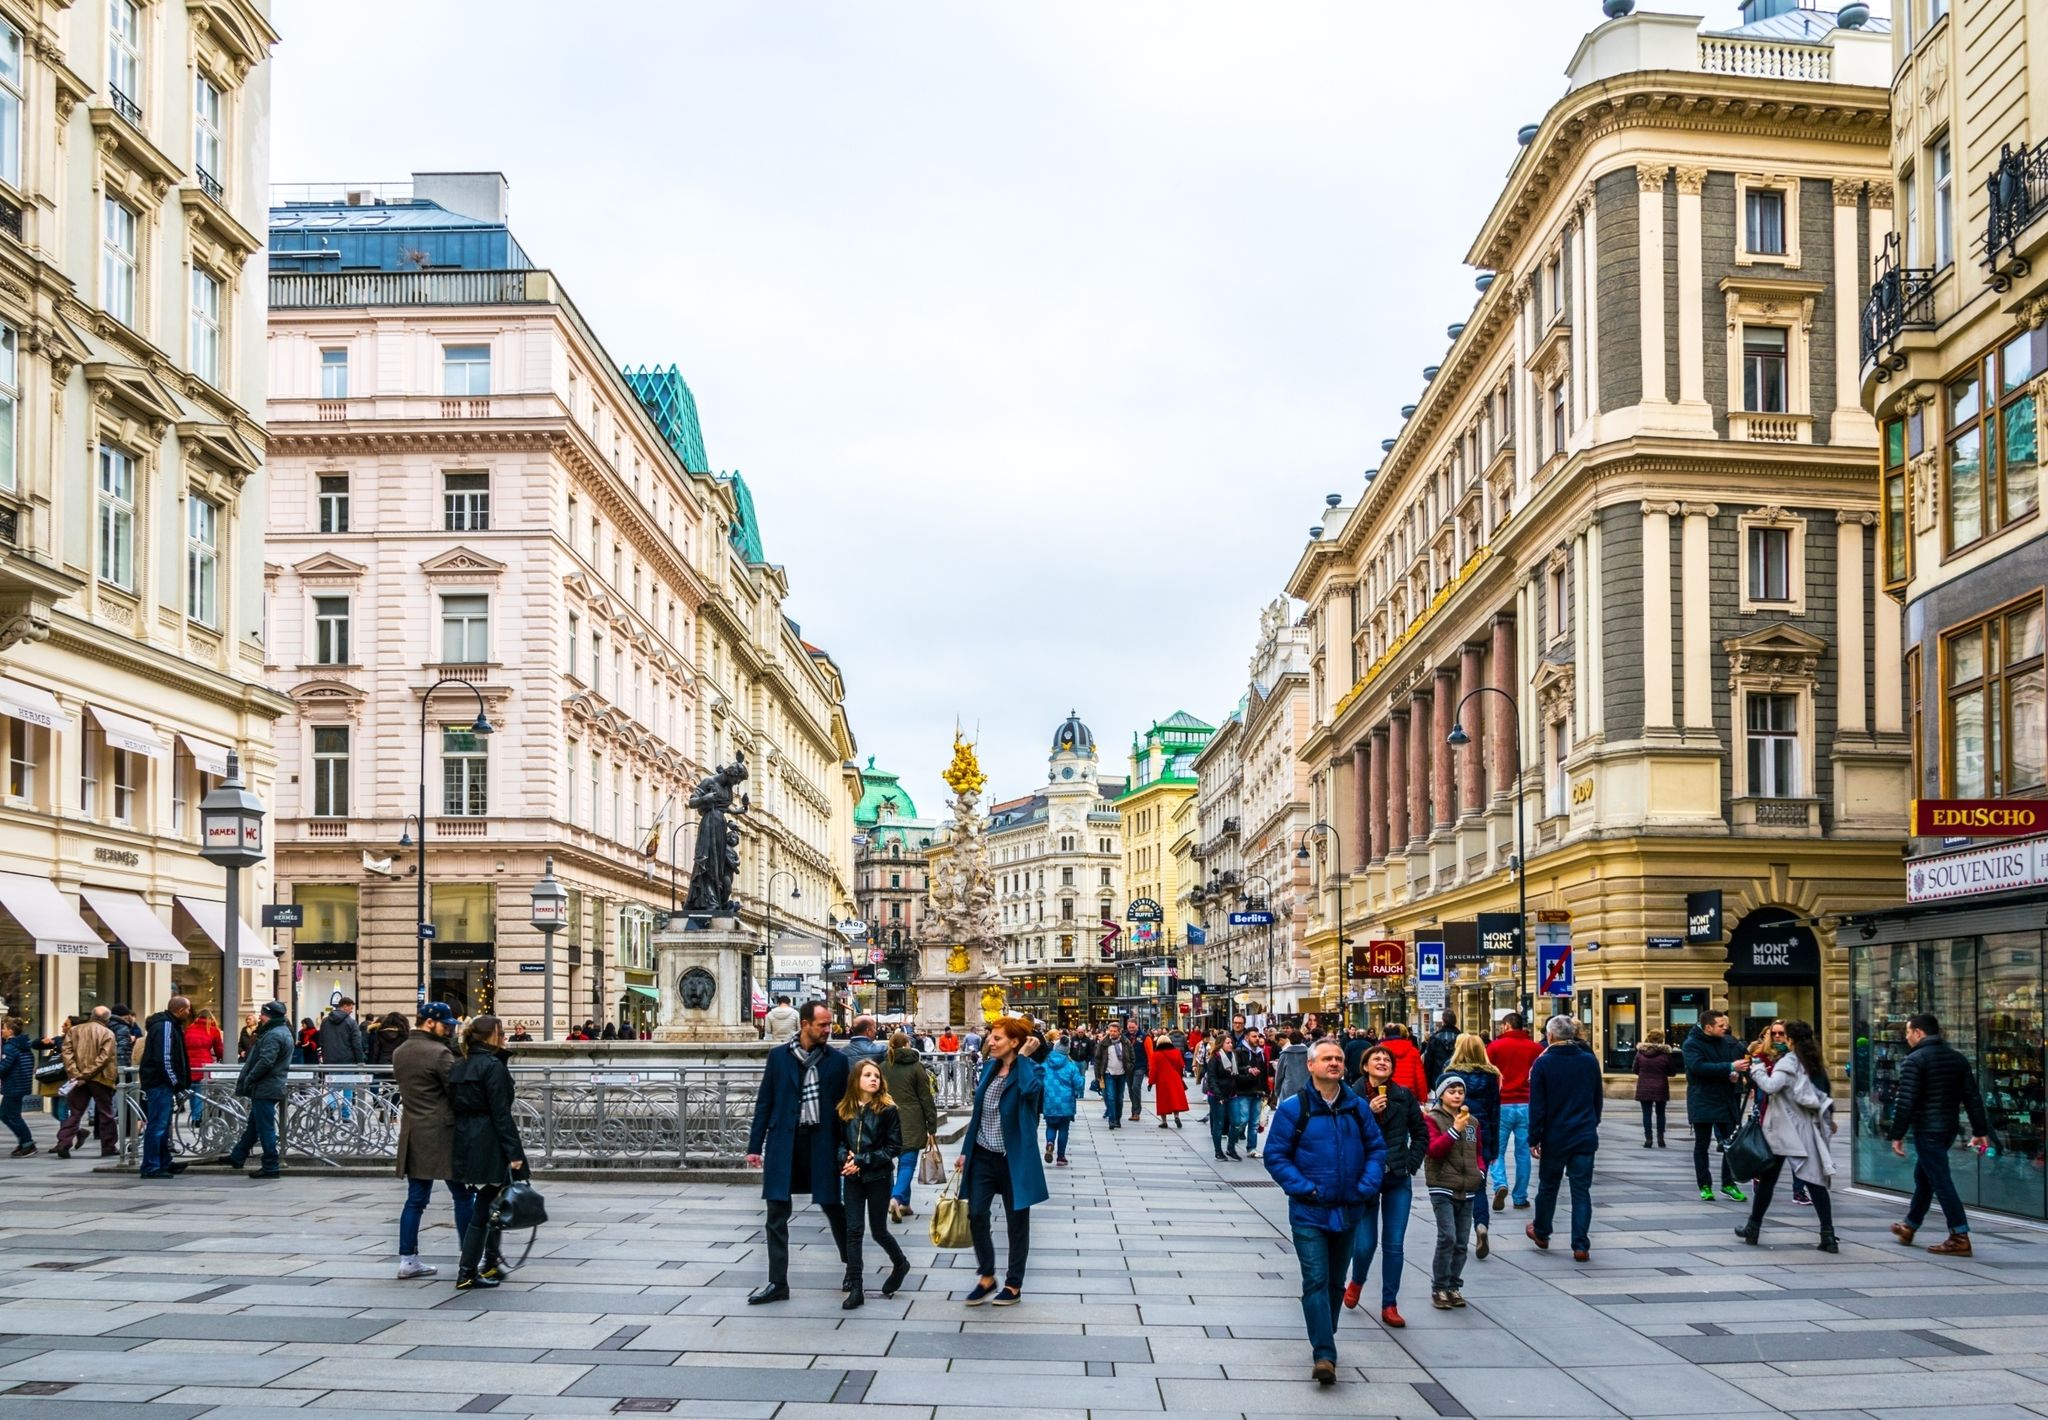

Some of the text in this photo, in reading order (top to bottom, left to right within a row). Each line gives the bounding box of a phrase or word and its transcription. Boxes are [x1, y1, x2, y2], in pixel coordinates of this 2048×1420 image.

[1932, 808, 2036, 827] EDUSCHO
[209, 828, 236, 836] DAMEN
[245, 827, 258, 840] WC
[1928, 853, 2024, 890] SOUVENIRS
[1234, 913, 1268, 923] Berlitz
[1689, 914, 1710, 926] MONT
[1690, 924, 1711, 936] BLANC
[1483, 932, 1513, 941] MONT
[1483, 941, 1513, 950] BLANC
[1752, 943, 1789, 954] MONT
[780, 959, 815, 968] BRAMO
[1753, 955, 1790, 965] BLANC
[1372, 965, 1404, 974] RAUCH
